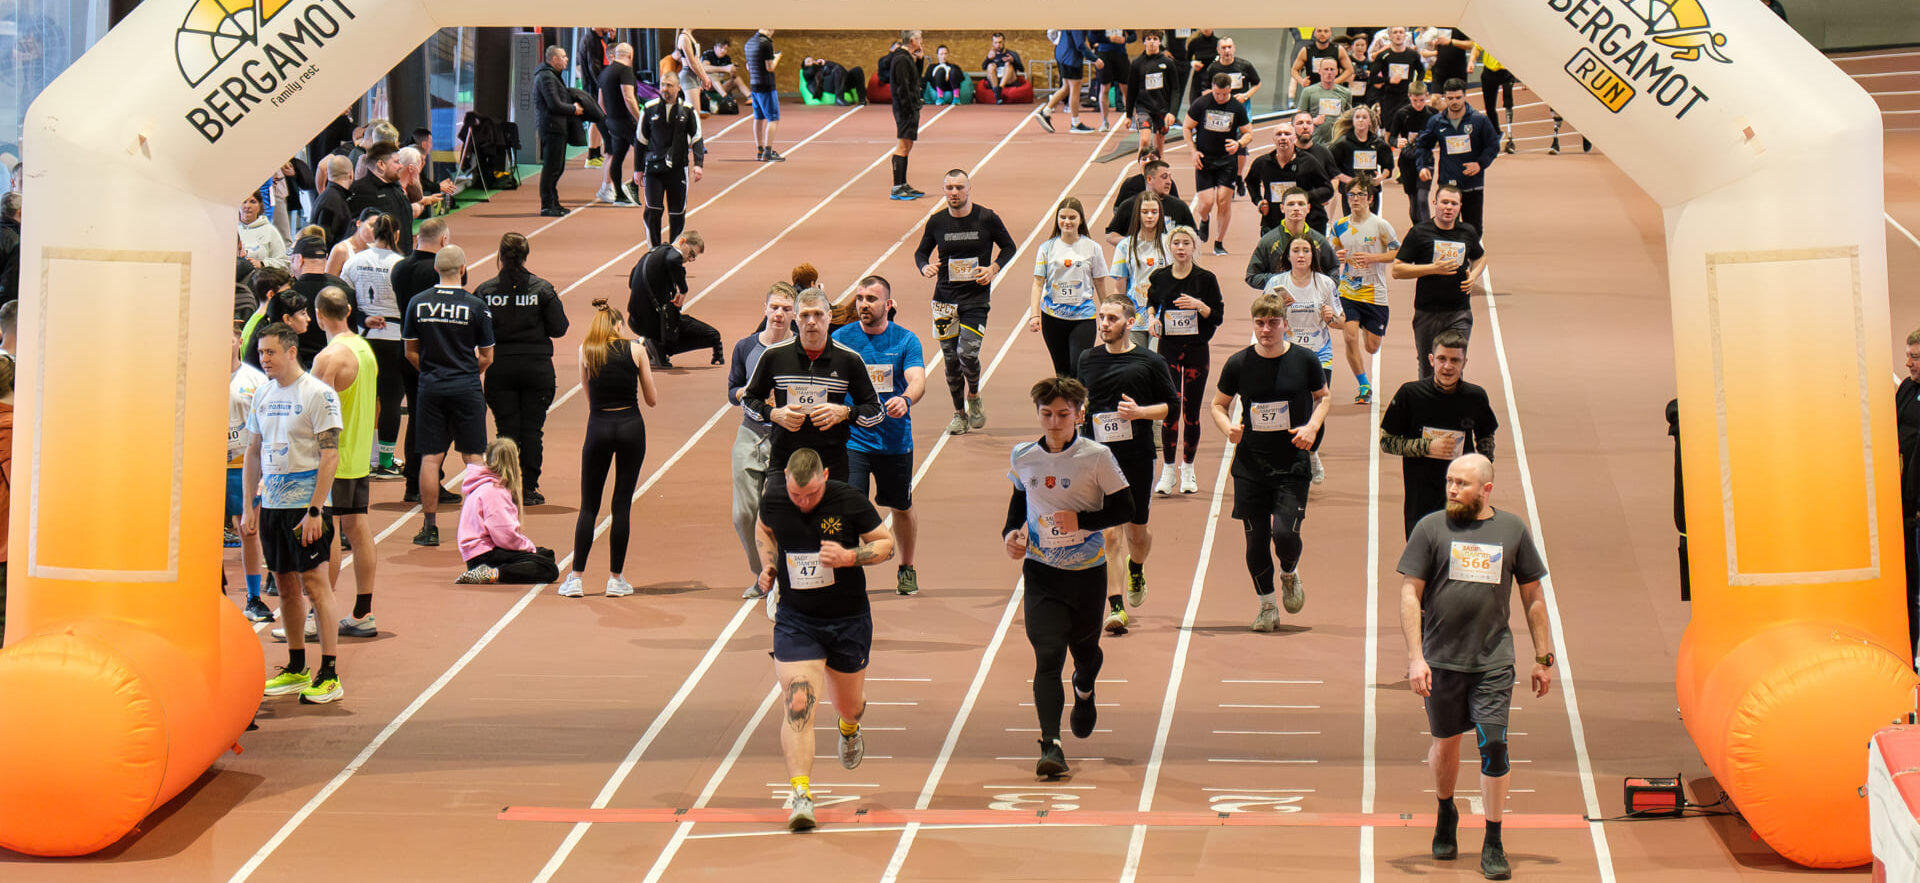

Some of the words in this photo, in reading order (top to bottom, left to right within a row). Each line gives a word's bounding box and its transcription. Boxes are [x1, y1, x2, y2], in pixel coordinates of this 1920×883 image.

[270, 79, 303, 108] family
[299, 63, 320, 86] rest
[1575, 57, 1626, 104] RUN
[1061, 288, 1073, 296] 51
[485, 294, 539, 306] ПОЛЦІЯ
[416, 302, 470, 321] ГУНП
[1172, 319, 1190, 327] 169
[1296, 335, 1310, 343] 70
[871, 374, 885, 383] 30
[799, 395, 815, 404] 66
[1261, 412, 1277, 421] 57
[1104, 422, 1119, 432] 68
[268, 453, 273, 463] 1
[1461, 556, 1491, 570] 566
[800, 565, 817, 576] 47
